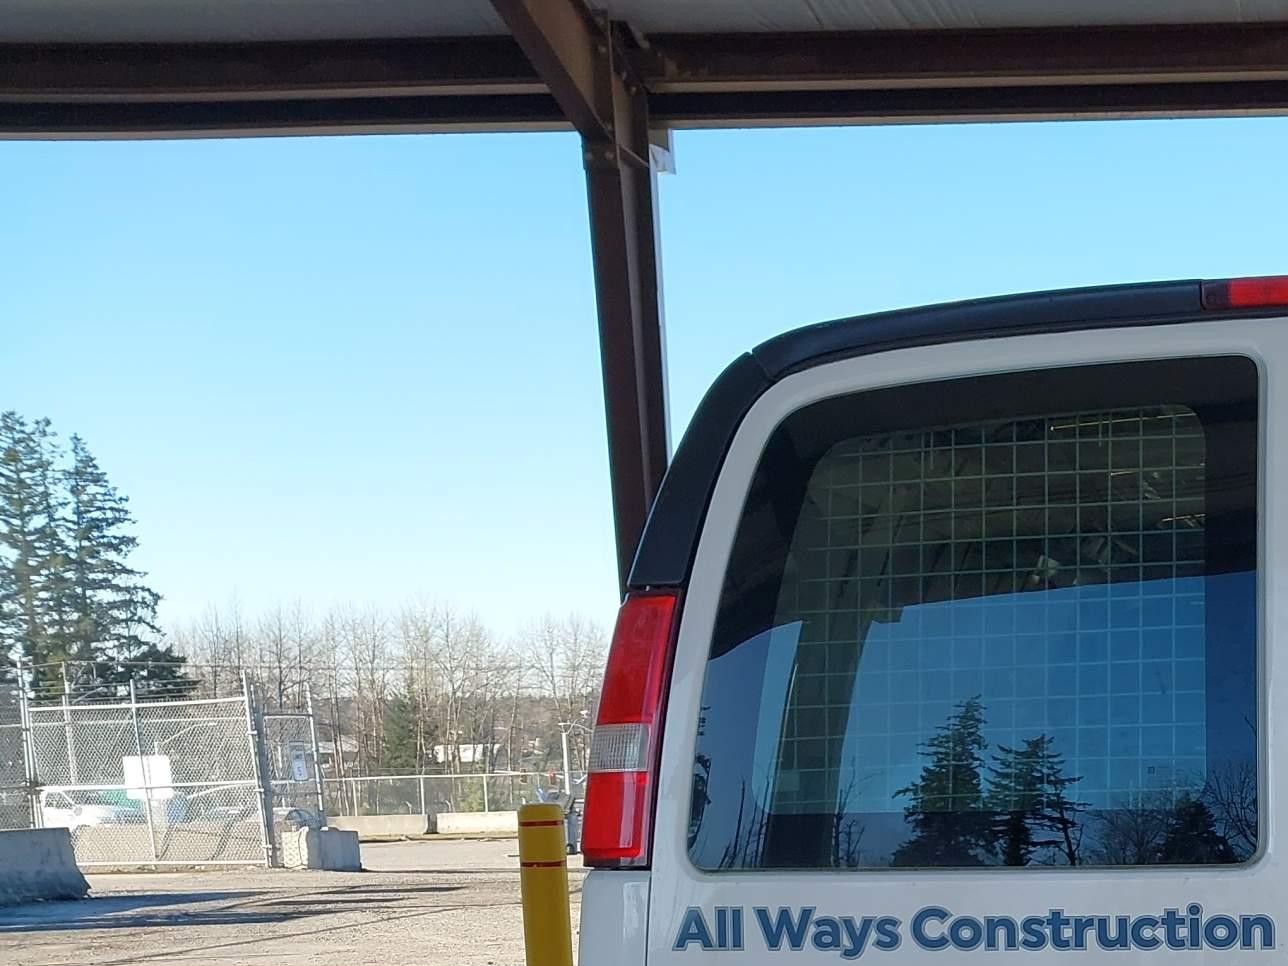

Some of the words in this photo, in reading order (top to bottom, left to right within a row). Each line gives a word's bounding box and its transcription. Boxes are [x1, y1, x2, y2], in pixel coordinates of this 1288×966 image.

[672, 906, 744, 951] All
[752, 906, 902, 960] Ways
[911, 903, 1275, 951] Construction
